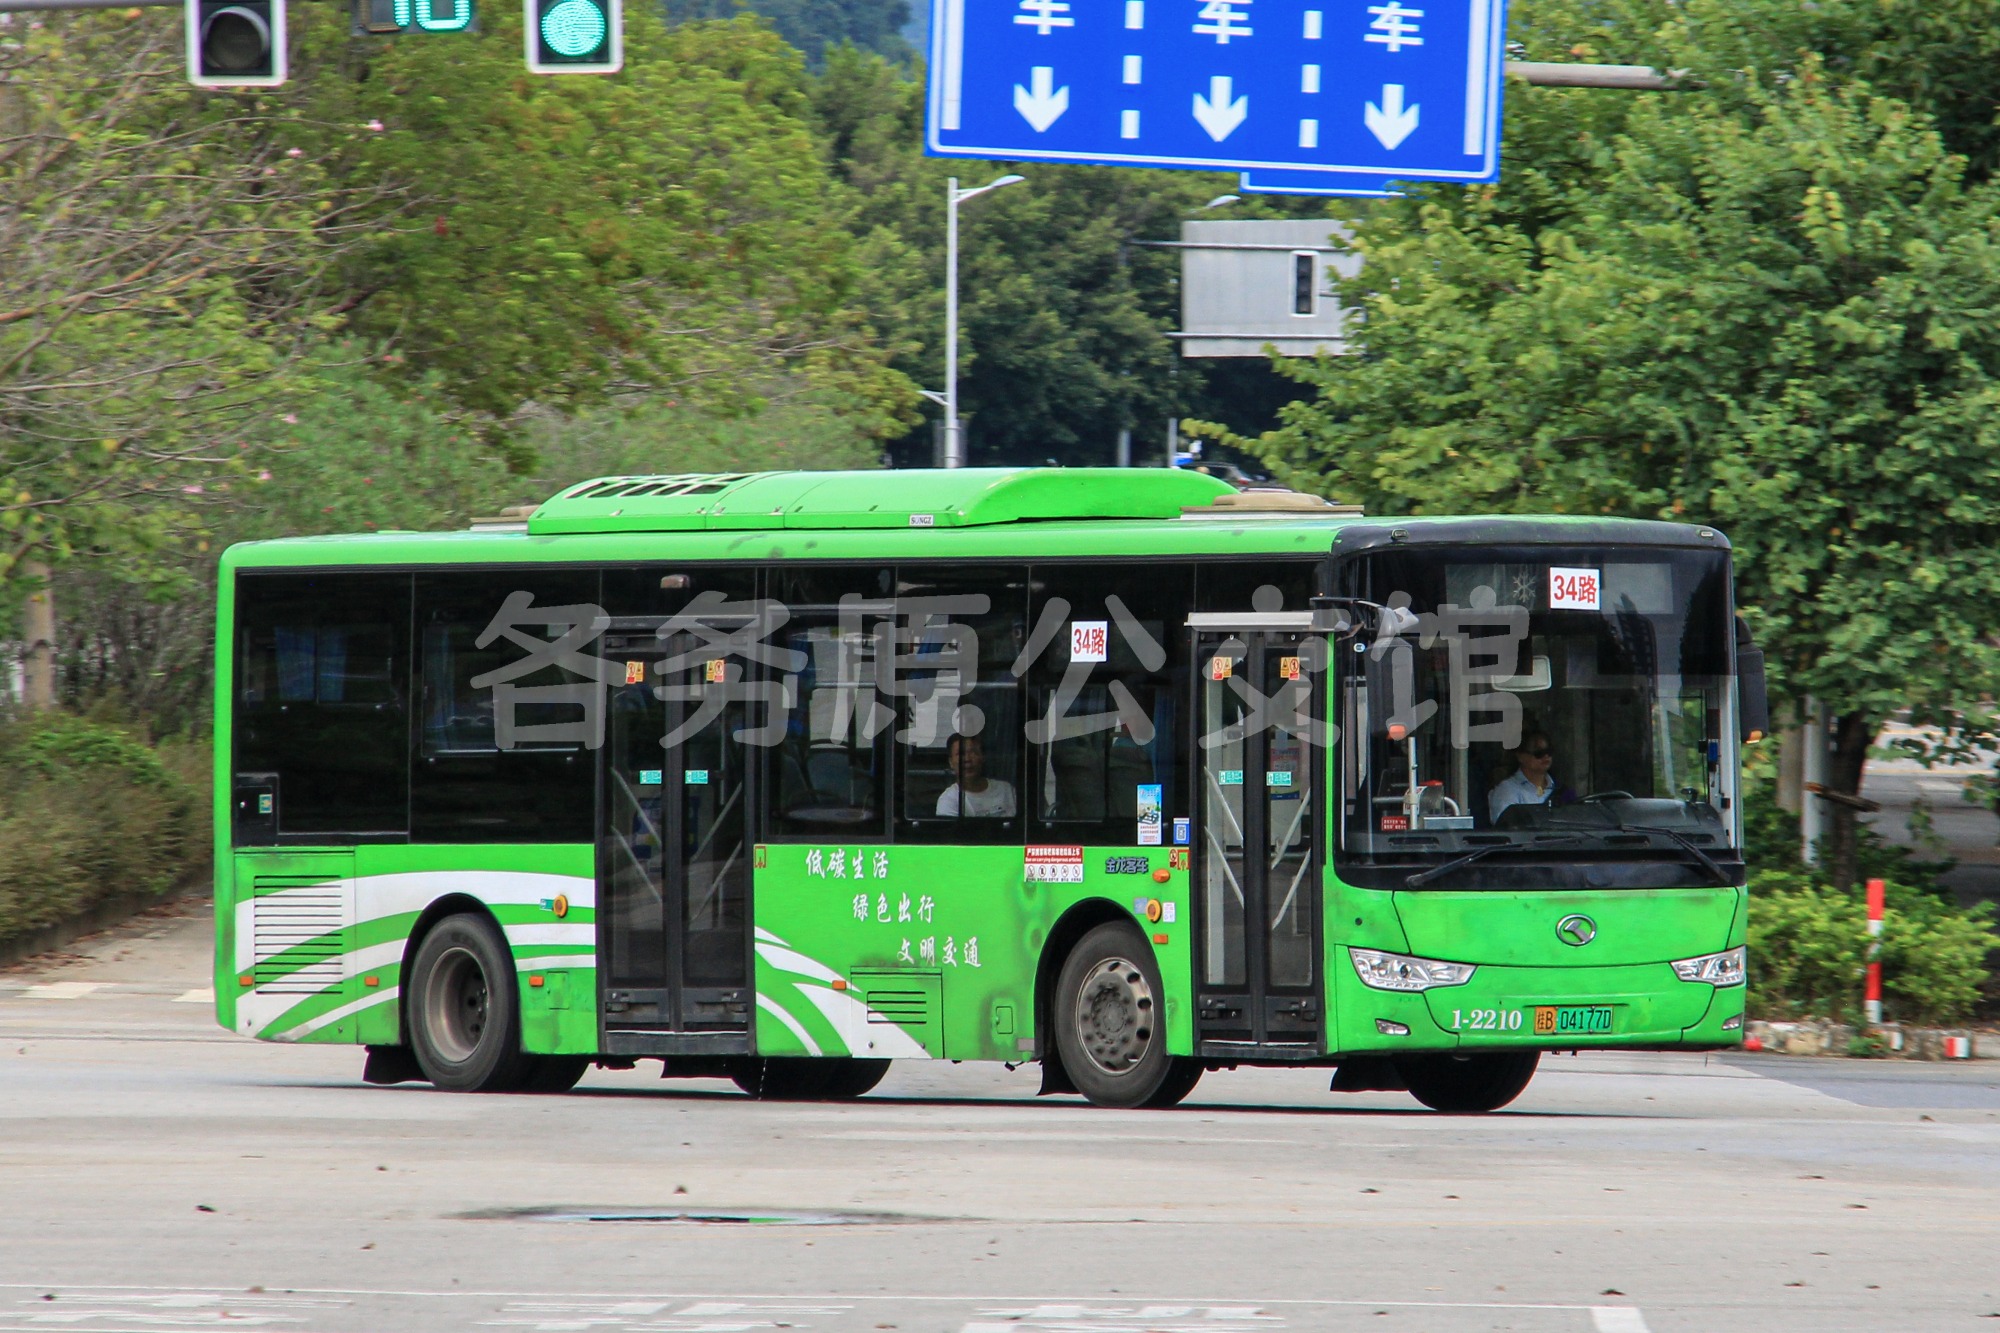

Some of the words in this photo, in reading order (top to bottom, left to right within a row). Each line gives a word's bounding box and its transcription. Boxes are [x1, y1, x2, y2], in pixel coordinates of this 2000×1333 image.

[1363, 0, 1424, 52] 车
[1554, 574, 1597, 604] 34路
[1073, 627, 1105, 655] 34路
[805, 849, 889, 879] 低碳生活
[1105, 857, 1149, 874] 金龙客车
[852, 892, 935, 923] 绿色出行
[897, 936, 982, 967] 文明交通
[1452, 1009, 1523, 1031] 1-2210
